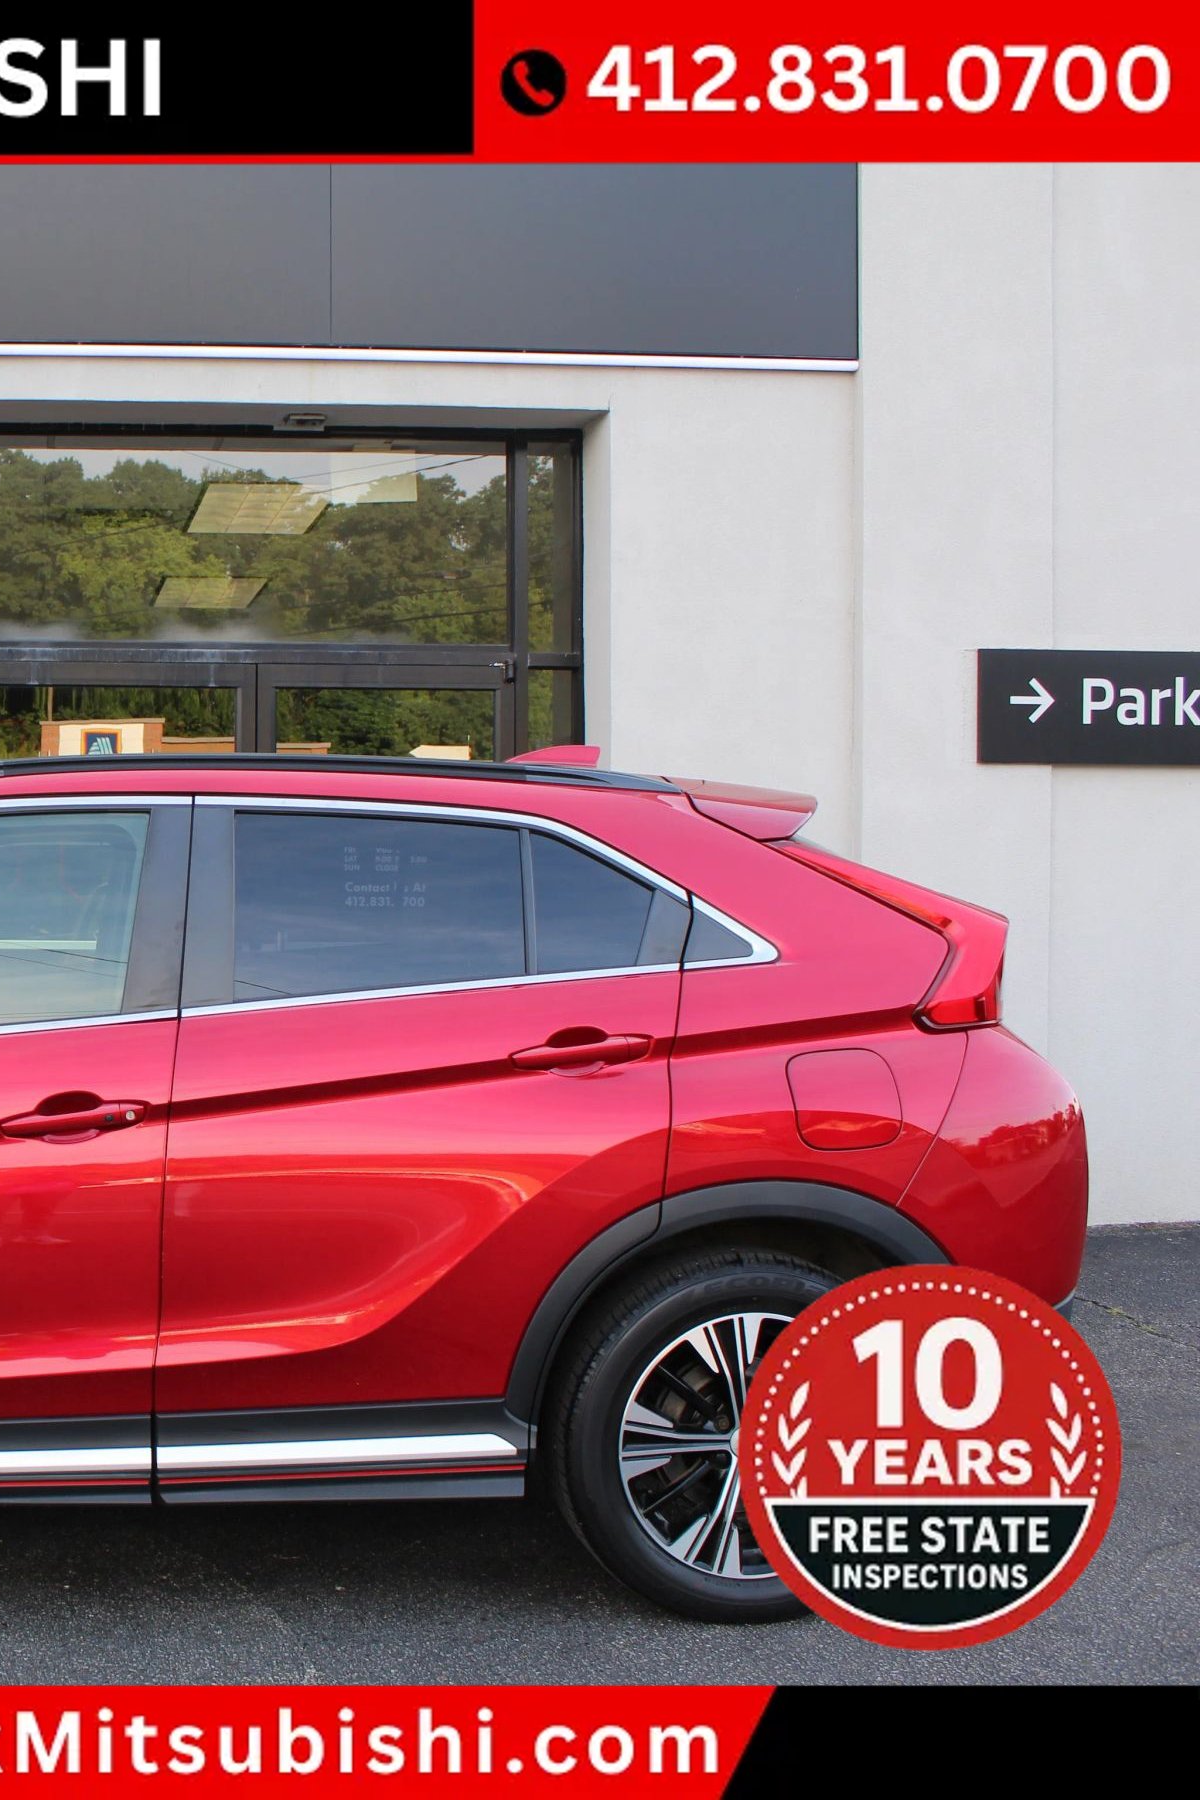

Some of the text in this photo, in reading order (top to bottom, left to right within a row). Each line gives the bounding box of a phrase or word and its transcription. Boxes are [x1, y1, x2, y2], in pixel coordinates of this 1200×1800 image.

[1081, 676, 1200, 726] Park
[345, 882, 390, 893] Contact
[345, 896, 426, 908] 412.831.700
